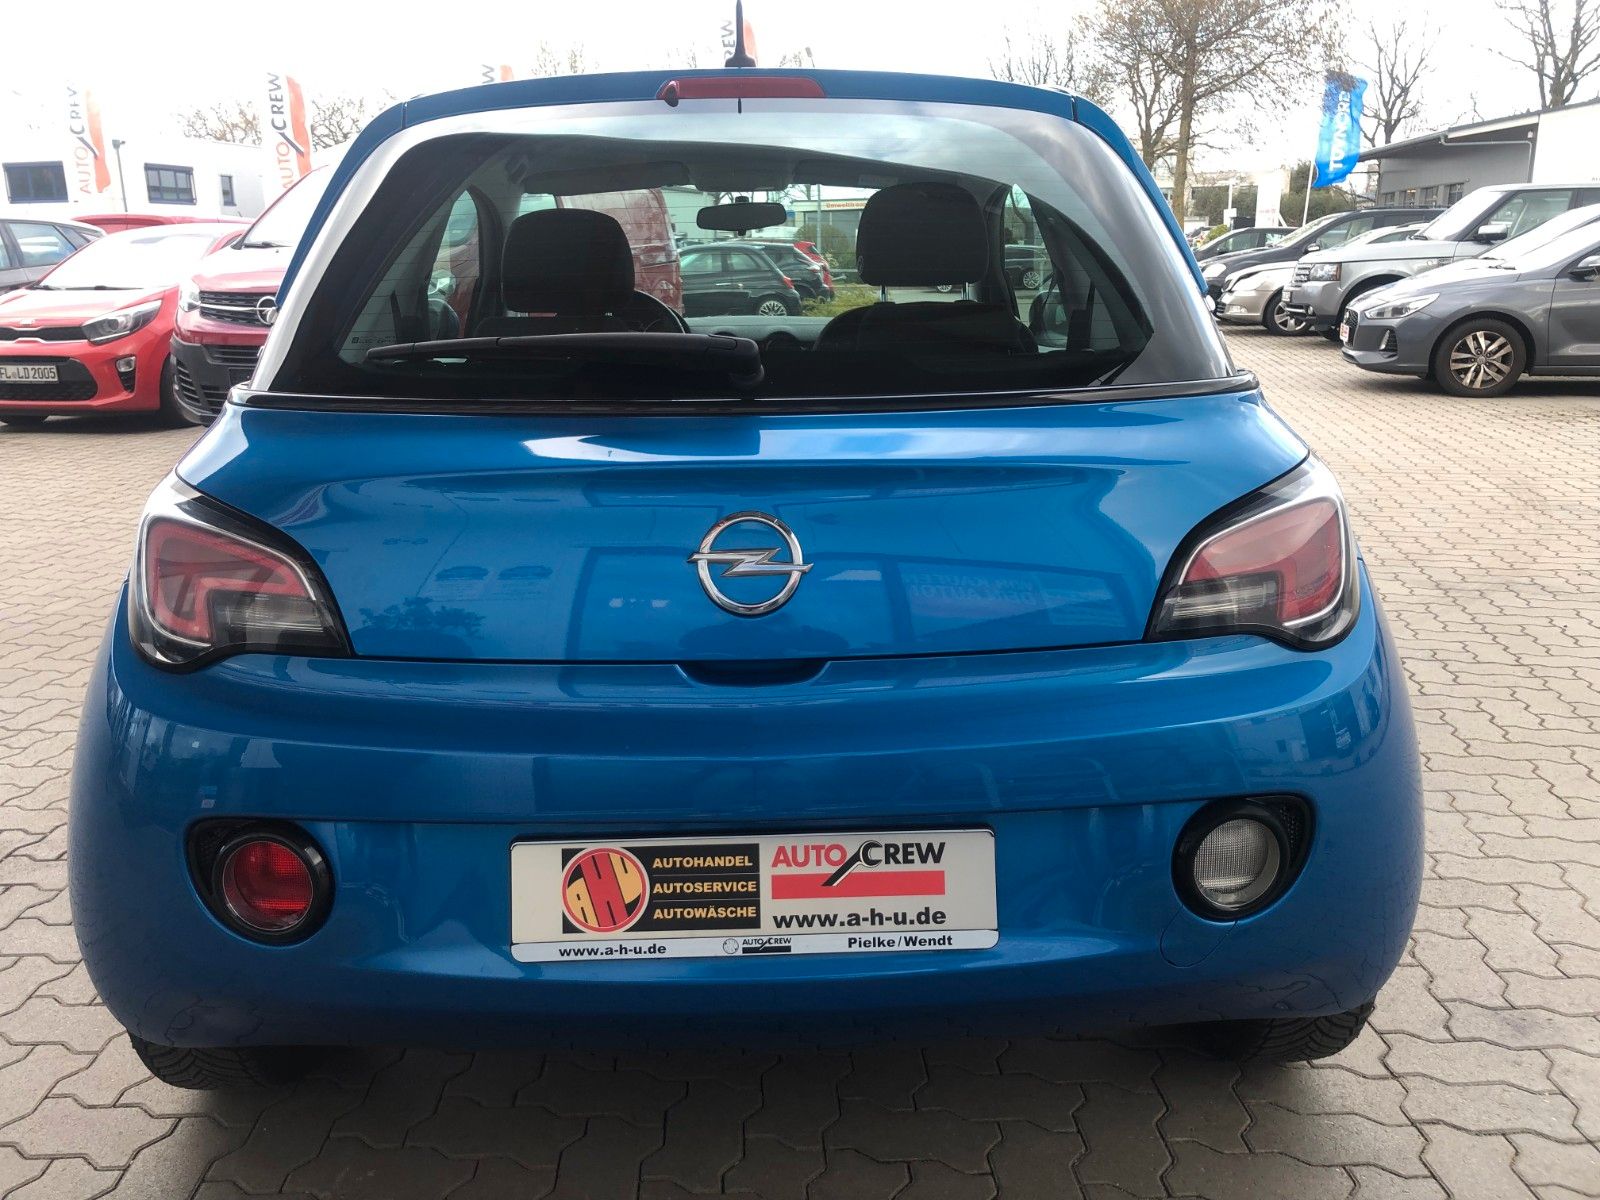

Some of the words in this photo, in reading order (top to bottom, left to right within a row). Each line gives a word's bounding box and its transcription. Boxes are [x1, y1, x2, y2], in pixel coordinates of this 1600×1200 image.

[267, 72, 287, 131] CREW
[74, 146, 92, 194] AUTO
[652, 855, 753, 869] AUTOHANDEL
[771, 843, 848, 868] AUTO
[860, 841, 946, 867] CREW
[652, 881, 757, 894] AUTOSERVICE
[653, 905, 757, 919] AUTOWÄSCHE
[772, 907, 947, 929] www.a-h-u.de
[558, 944, 667, 957] www.a-h-u.de
